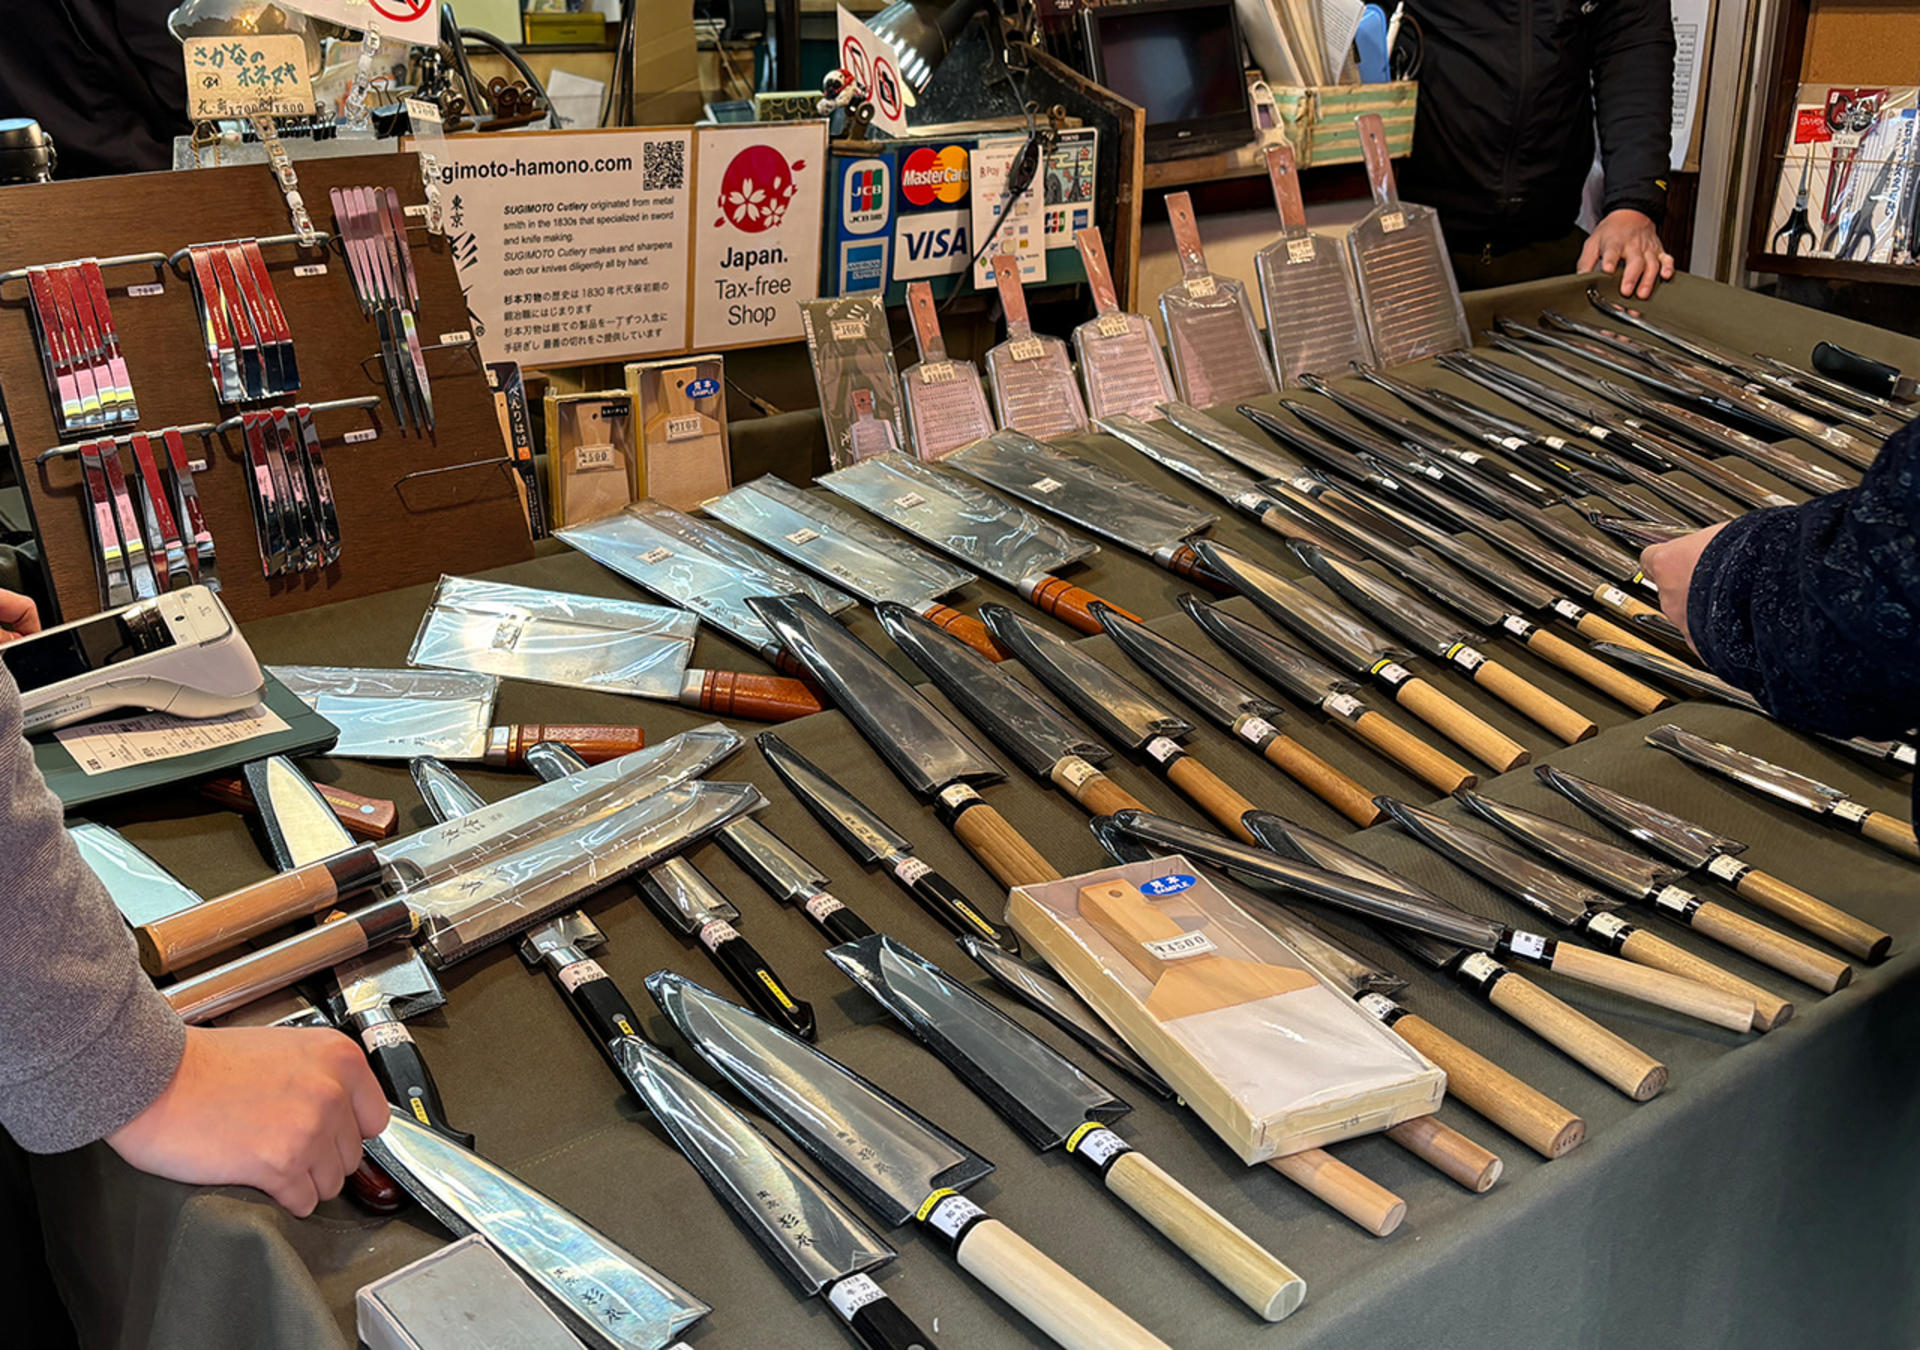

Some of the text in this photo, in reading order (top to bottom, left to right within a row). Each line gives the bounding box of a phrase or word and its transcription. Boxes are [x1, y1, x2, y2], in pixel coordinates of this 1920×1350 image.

[193, 43, 265, 68] さかなの
[436, 157, 633, 184] gimoto-hamono.com
[851, 185, 882, 197] JCB
[451, 194, 464, 228] 東京
[504, 195, 674, 215] SUGIMOTO Cutlery originated from metal
[503, 210, 674, 231] smith in the 1830s that specialized in sword
[503, 236, 519, 246] and
[521, 234, 541, 244] knife
[503, 241, 673, 262] SUGIMOTO Cutlery makes and sharpens
[902, 227, 967, 261] VISA
[503, 268, 524, 277] each
[526, 266, 539, 275] our
[541, 263, 567, 274] knives
[569, 260, 603, 273] diligently
[605, 259, 615, 269] all
[616, 258, 626, 270] by
[720, 246, 788, 270] Japan.
[715, 277, 792, 300] Tax-free
[728, 304, 776, 327] Shop
[508, 387, 528, 447] べんりはけ
